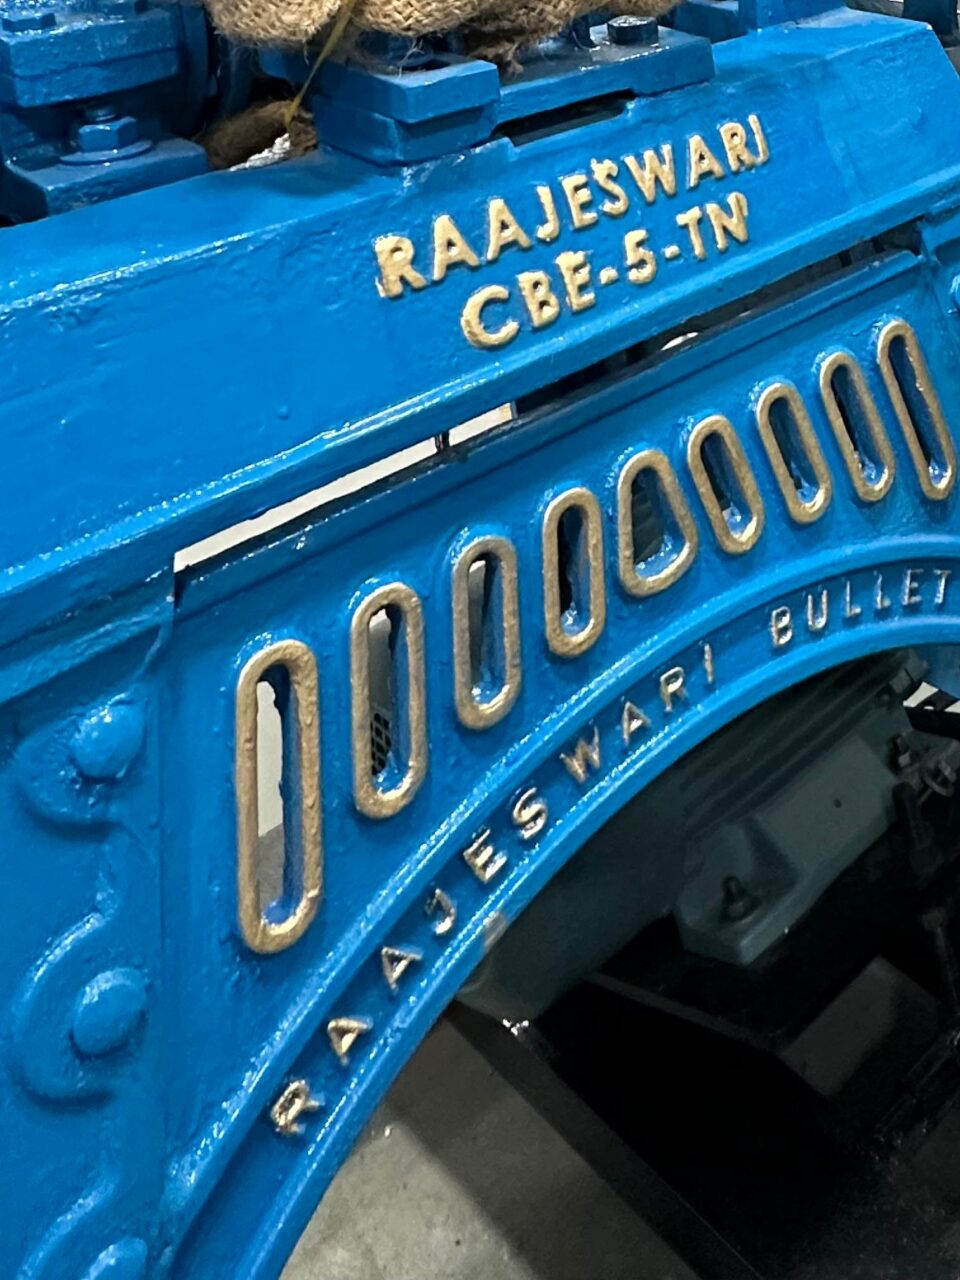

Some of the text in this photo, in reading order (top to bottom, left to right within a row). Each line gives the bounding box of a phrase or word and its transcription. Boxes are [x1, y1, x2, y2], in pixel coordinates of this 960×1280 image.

[374, 113, 770, 299] RAAJESWARI
[460, 191, 749, 349] CBE-5-TN
[270, 568, 951, 1135] RAAJESWARI BULLET
